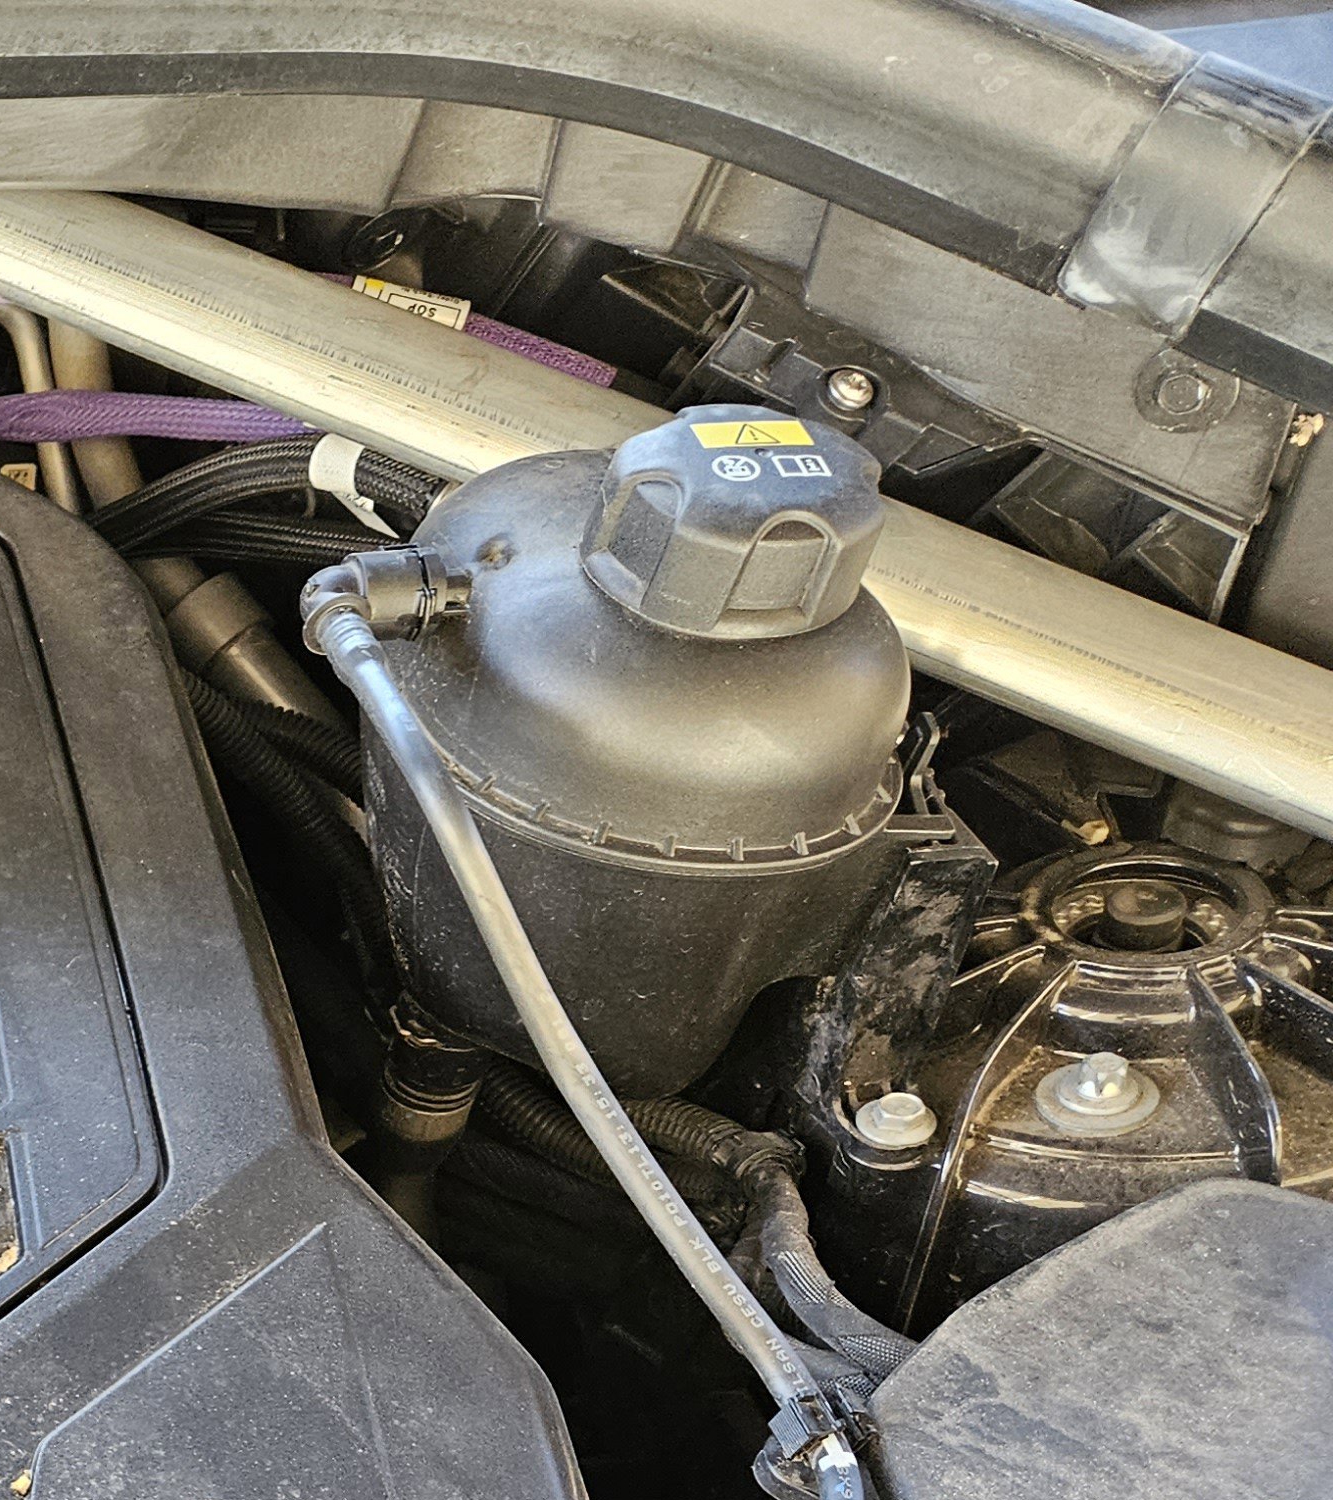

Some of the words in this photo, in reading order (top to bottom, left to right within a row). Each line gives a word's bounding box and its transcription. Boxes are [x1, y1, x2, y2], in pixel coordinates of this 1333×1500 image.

[688, 1236, 722, 1274] BLK
[723, 1283, 765, 1329] CESU
[765, 1337, 809, 1394] ILSAN
